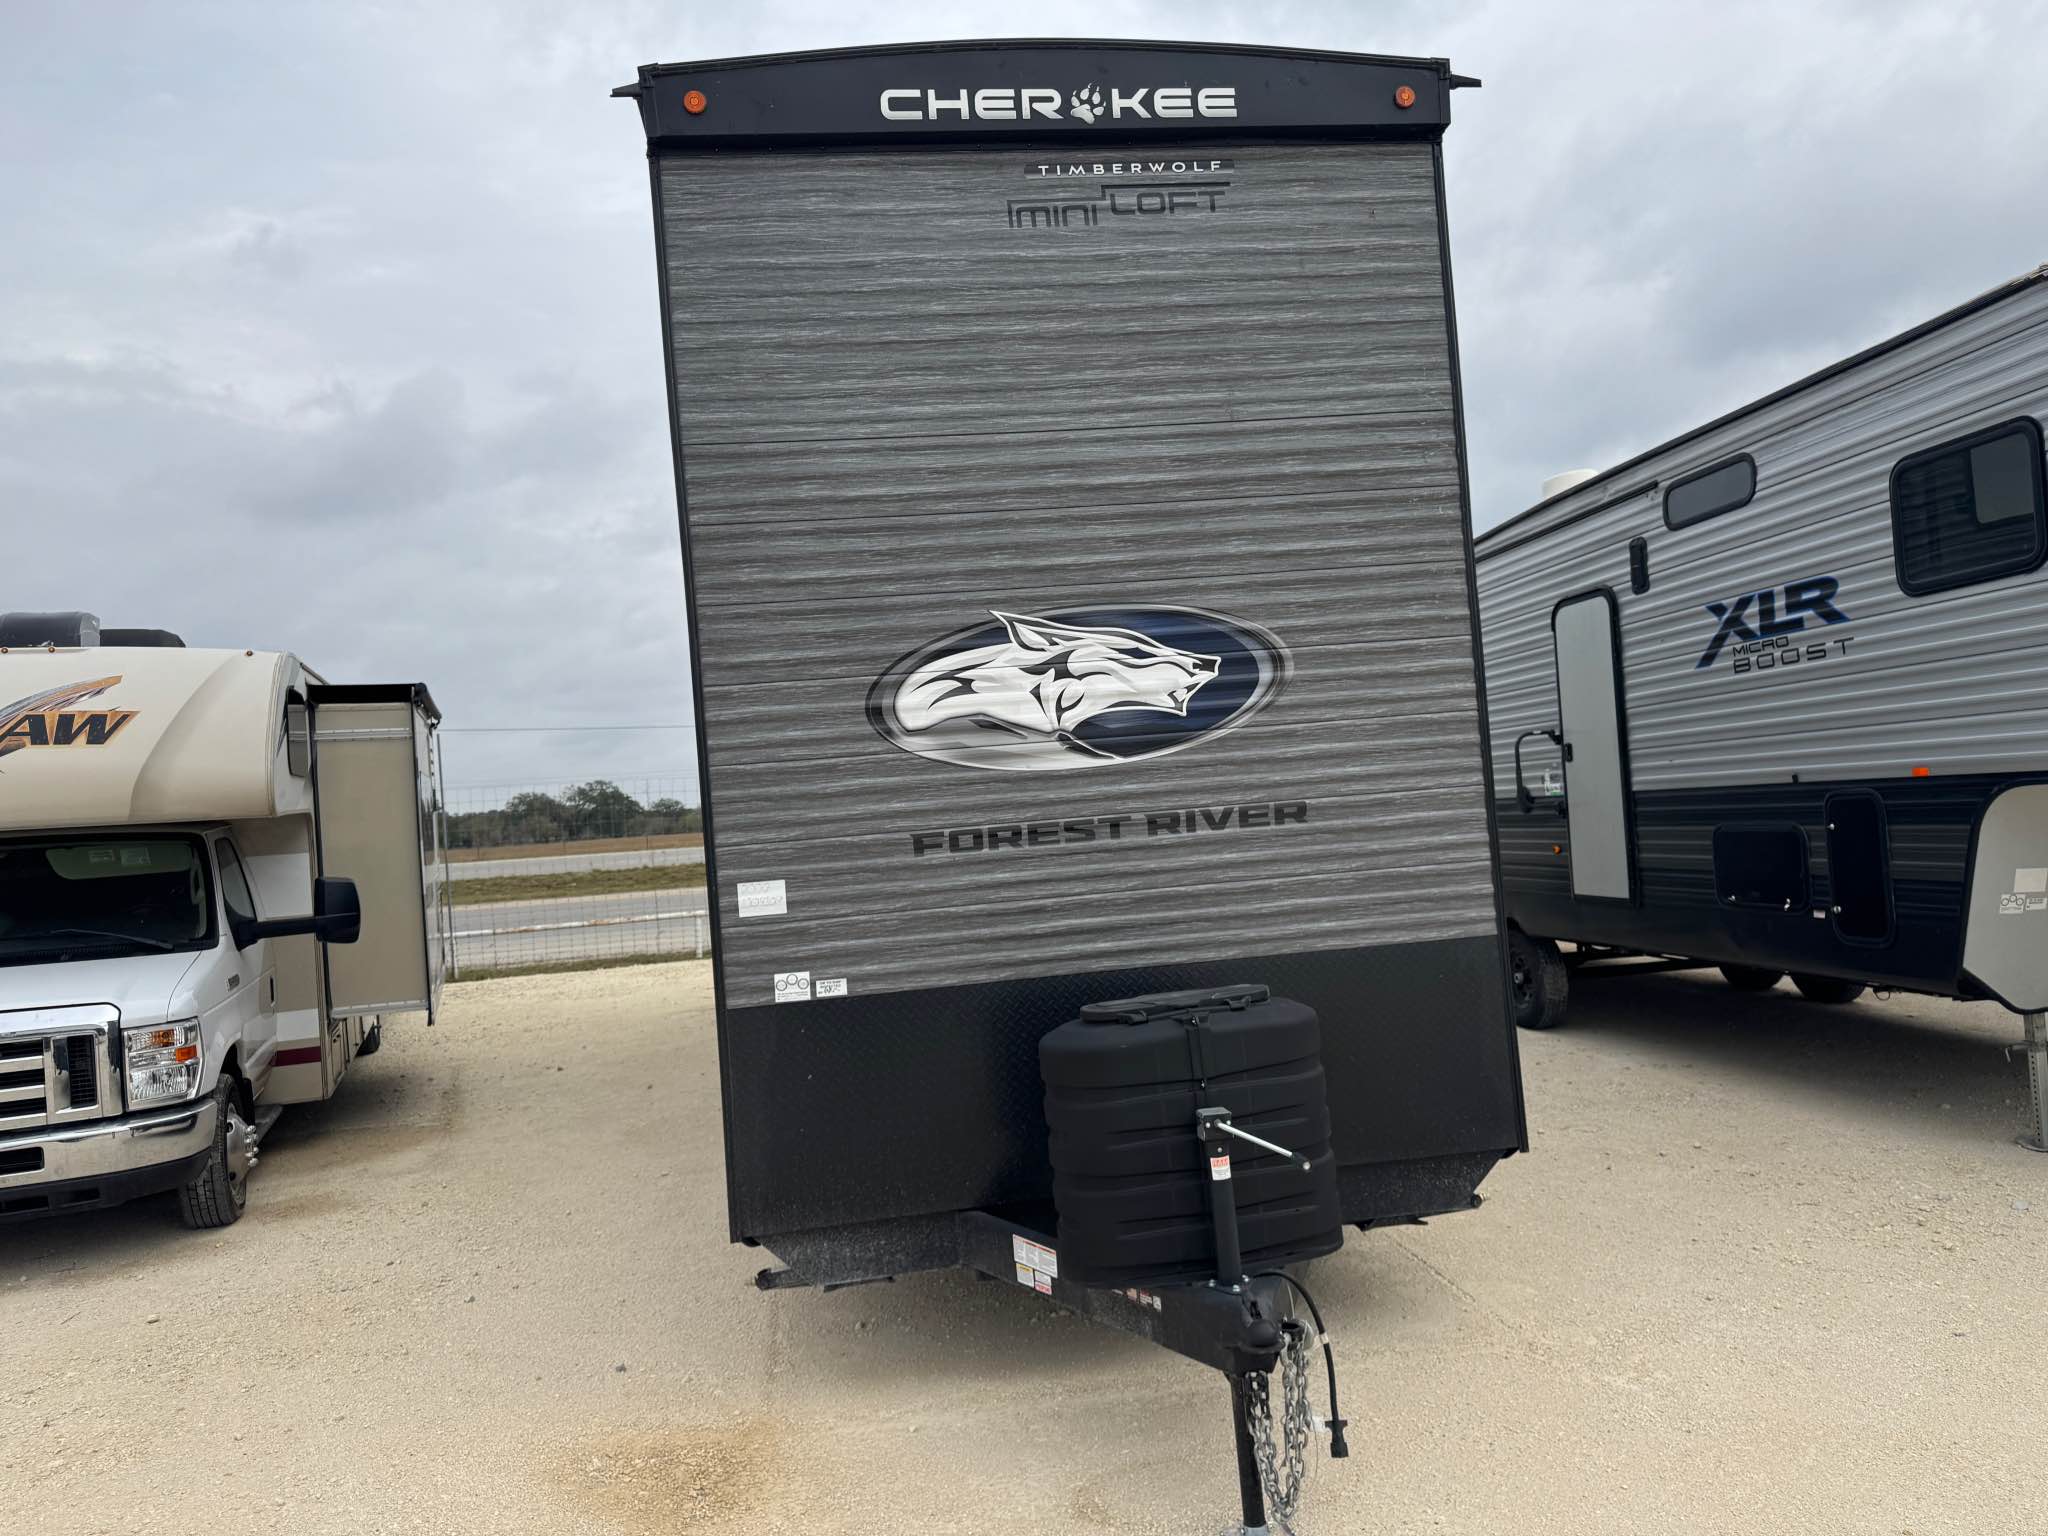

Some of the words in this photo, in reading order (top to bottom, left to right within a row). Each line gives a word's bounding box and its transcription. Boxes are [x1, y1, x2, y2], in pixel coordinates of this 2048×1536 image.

[1038, 161, 1222, 178] TIMBERWOLF
[1110, 190, 1225, 216] LOFT
[1696, 575, 1851, 669] XLR
[1733, 636, 1789, 657] MICRO
[1733, 637, 1854, 674] BOOST
[909, 814, 1133, 857] FOREST
[1144, 800, 1309, 837] RIVER
